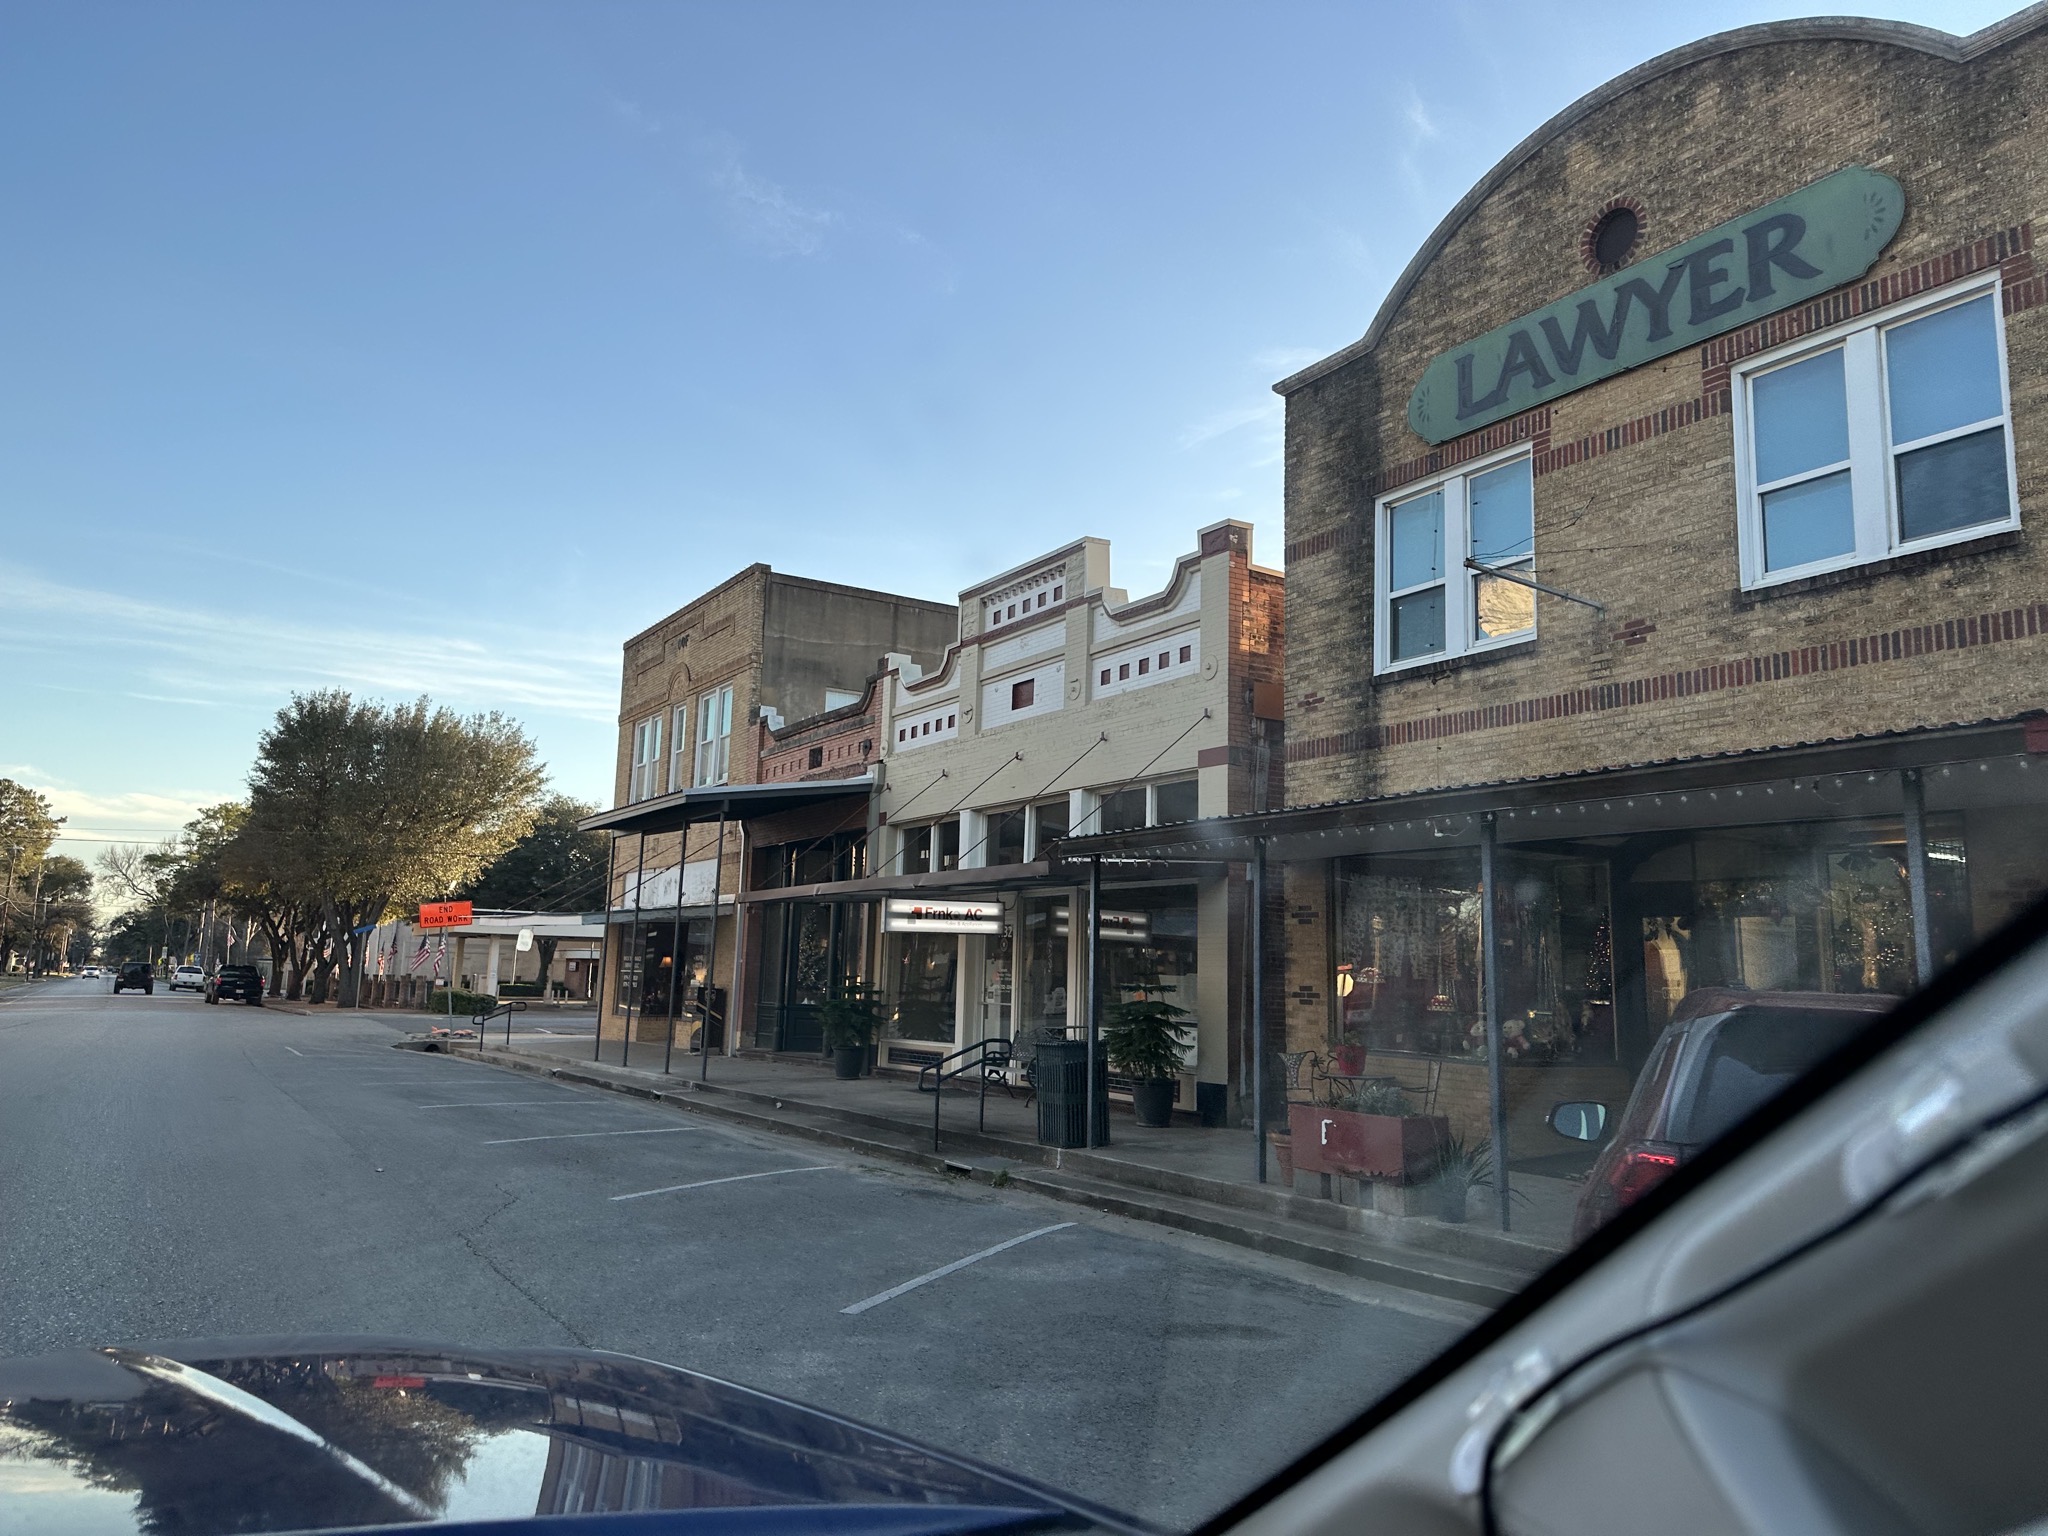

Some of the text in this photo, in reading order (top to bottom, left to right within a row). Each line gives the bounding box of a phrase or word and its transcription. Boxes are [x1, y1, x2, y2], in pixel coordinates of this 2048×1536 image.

[1454, 213, 1824, 422] LAWYER
[438, 905, 454, 914] END
[964, 907, 984, 921] AC
[424, 914, 469, 924] ROAD WORK
